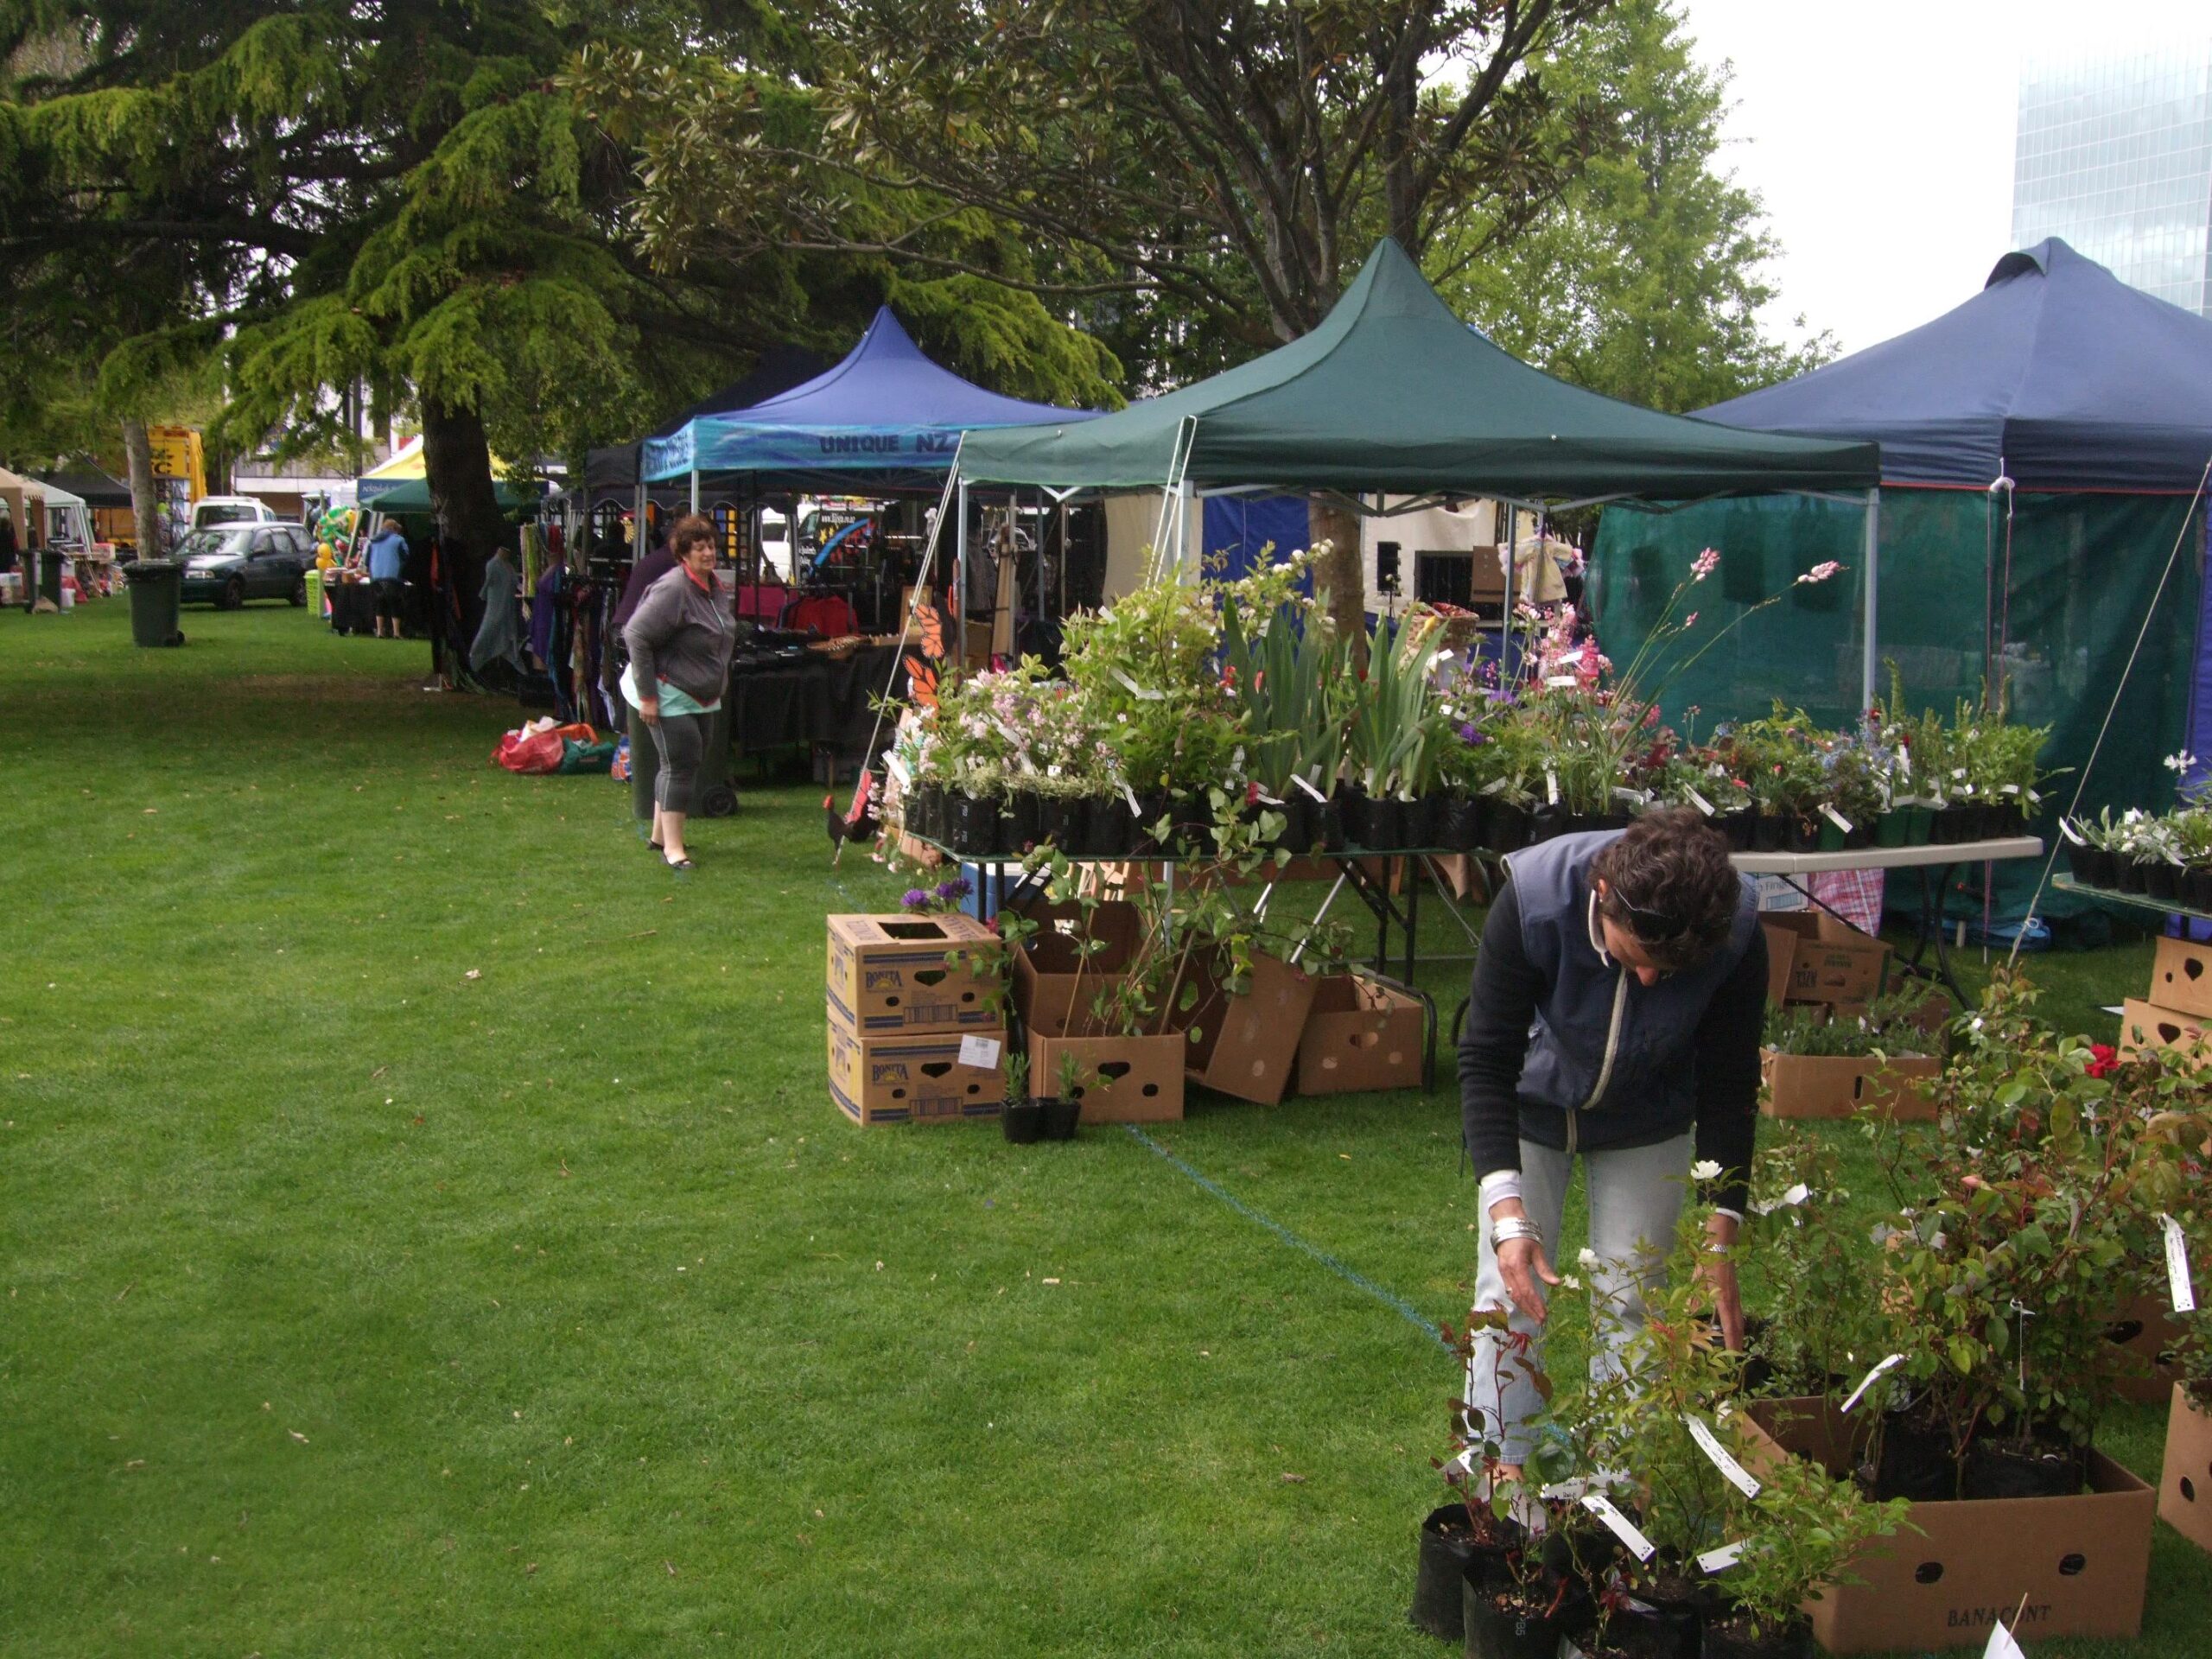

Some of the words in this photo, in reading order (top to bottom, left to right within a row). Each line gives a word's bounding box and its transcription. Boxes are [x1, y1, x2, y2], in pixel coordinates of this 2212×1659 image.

[820, 435, 899, 453] UNIQUE
[916, 433, 949, 452] NZ
[866, 969, 902, 988] BONITA
[872, 1063, 909, 1082] BONITA
[1948, 1605, 2051, 1627] BANACONT
